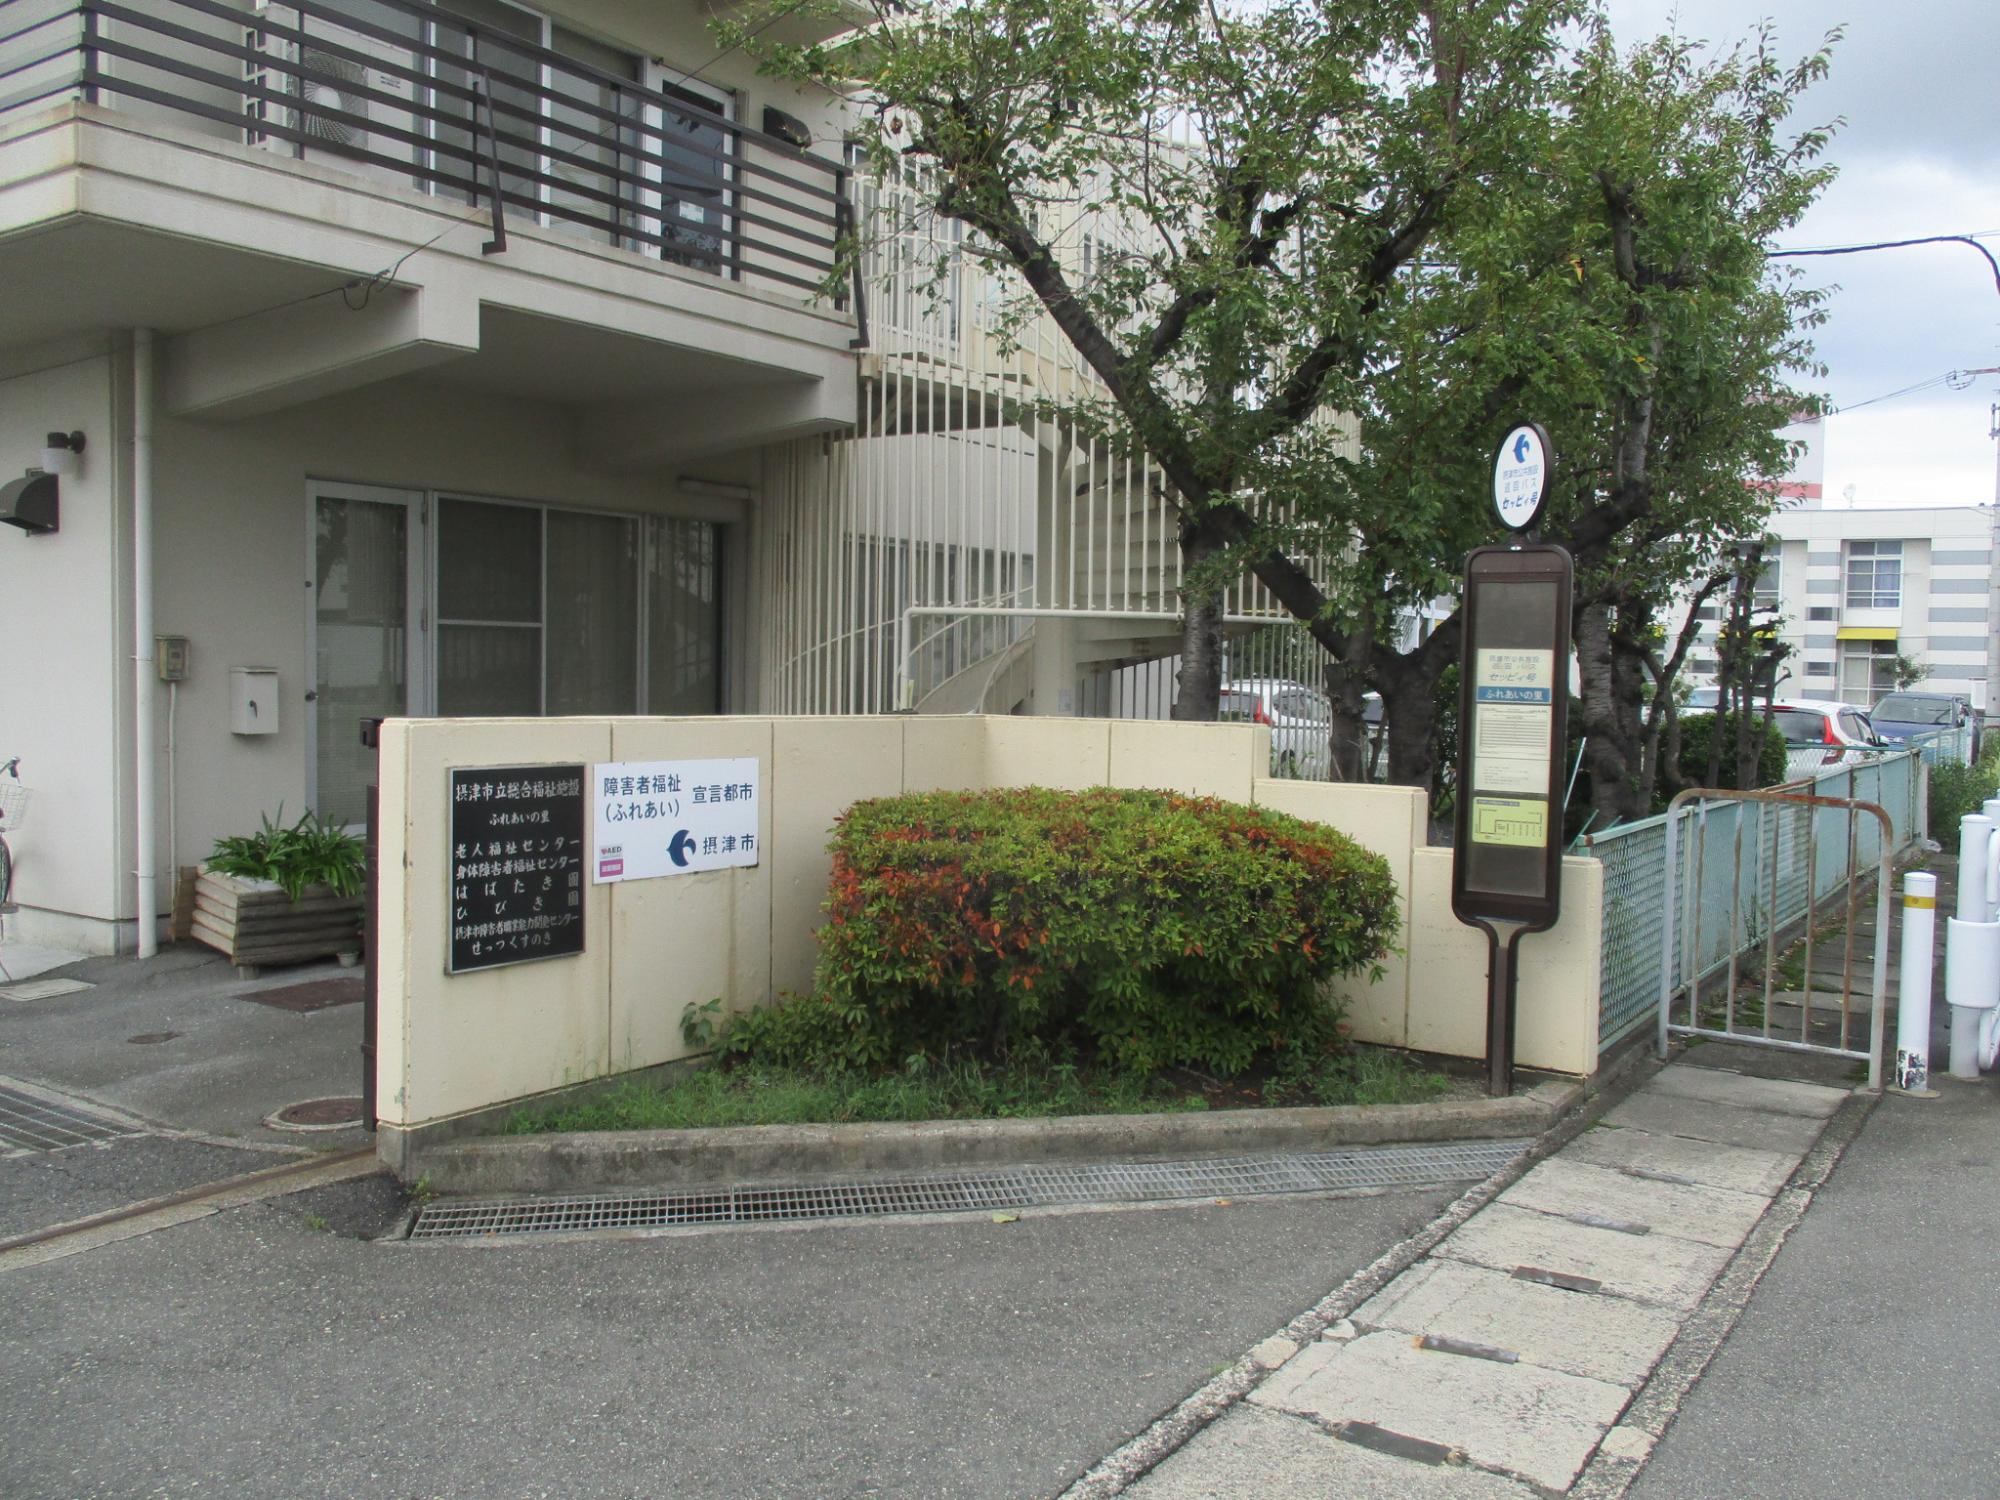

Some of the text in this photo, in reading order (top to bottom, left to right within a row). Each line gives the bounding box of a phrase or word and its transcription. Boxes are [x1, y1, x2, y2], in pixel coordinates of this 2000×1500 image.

[1485, 688, 1543, 700] ふれあいの里
[455, 778, 580, 802] 摂津市立総合福祉施設
[603, 773, 682, 797] 障害者福祉
[692, 783, 754, 804] 宣言都市
[488, 810, 551, 826] ふれあいの里
[605, 798, 680, 823] (ふれあい)
[455, 836, 580, 860] 老人福祉センター
[608, 846, 622, 854] AED
[703, 833, 755, 856] 摂津市
[456, 855, 580, 881] 身体障害者福祉センター
[472, 933, 552, 956] せっつくすのき
